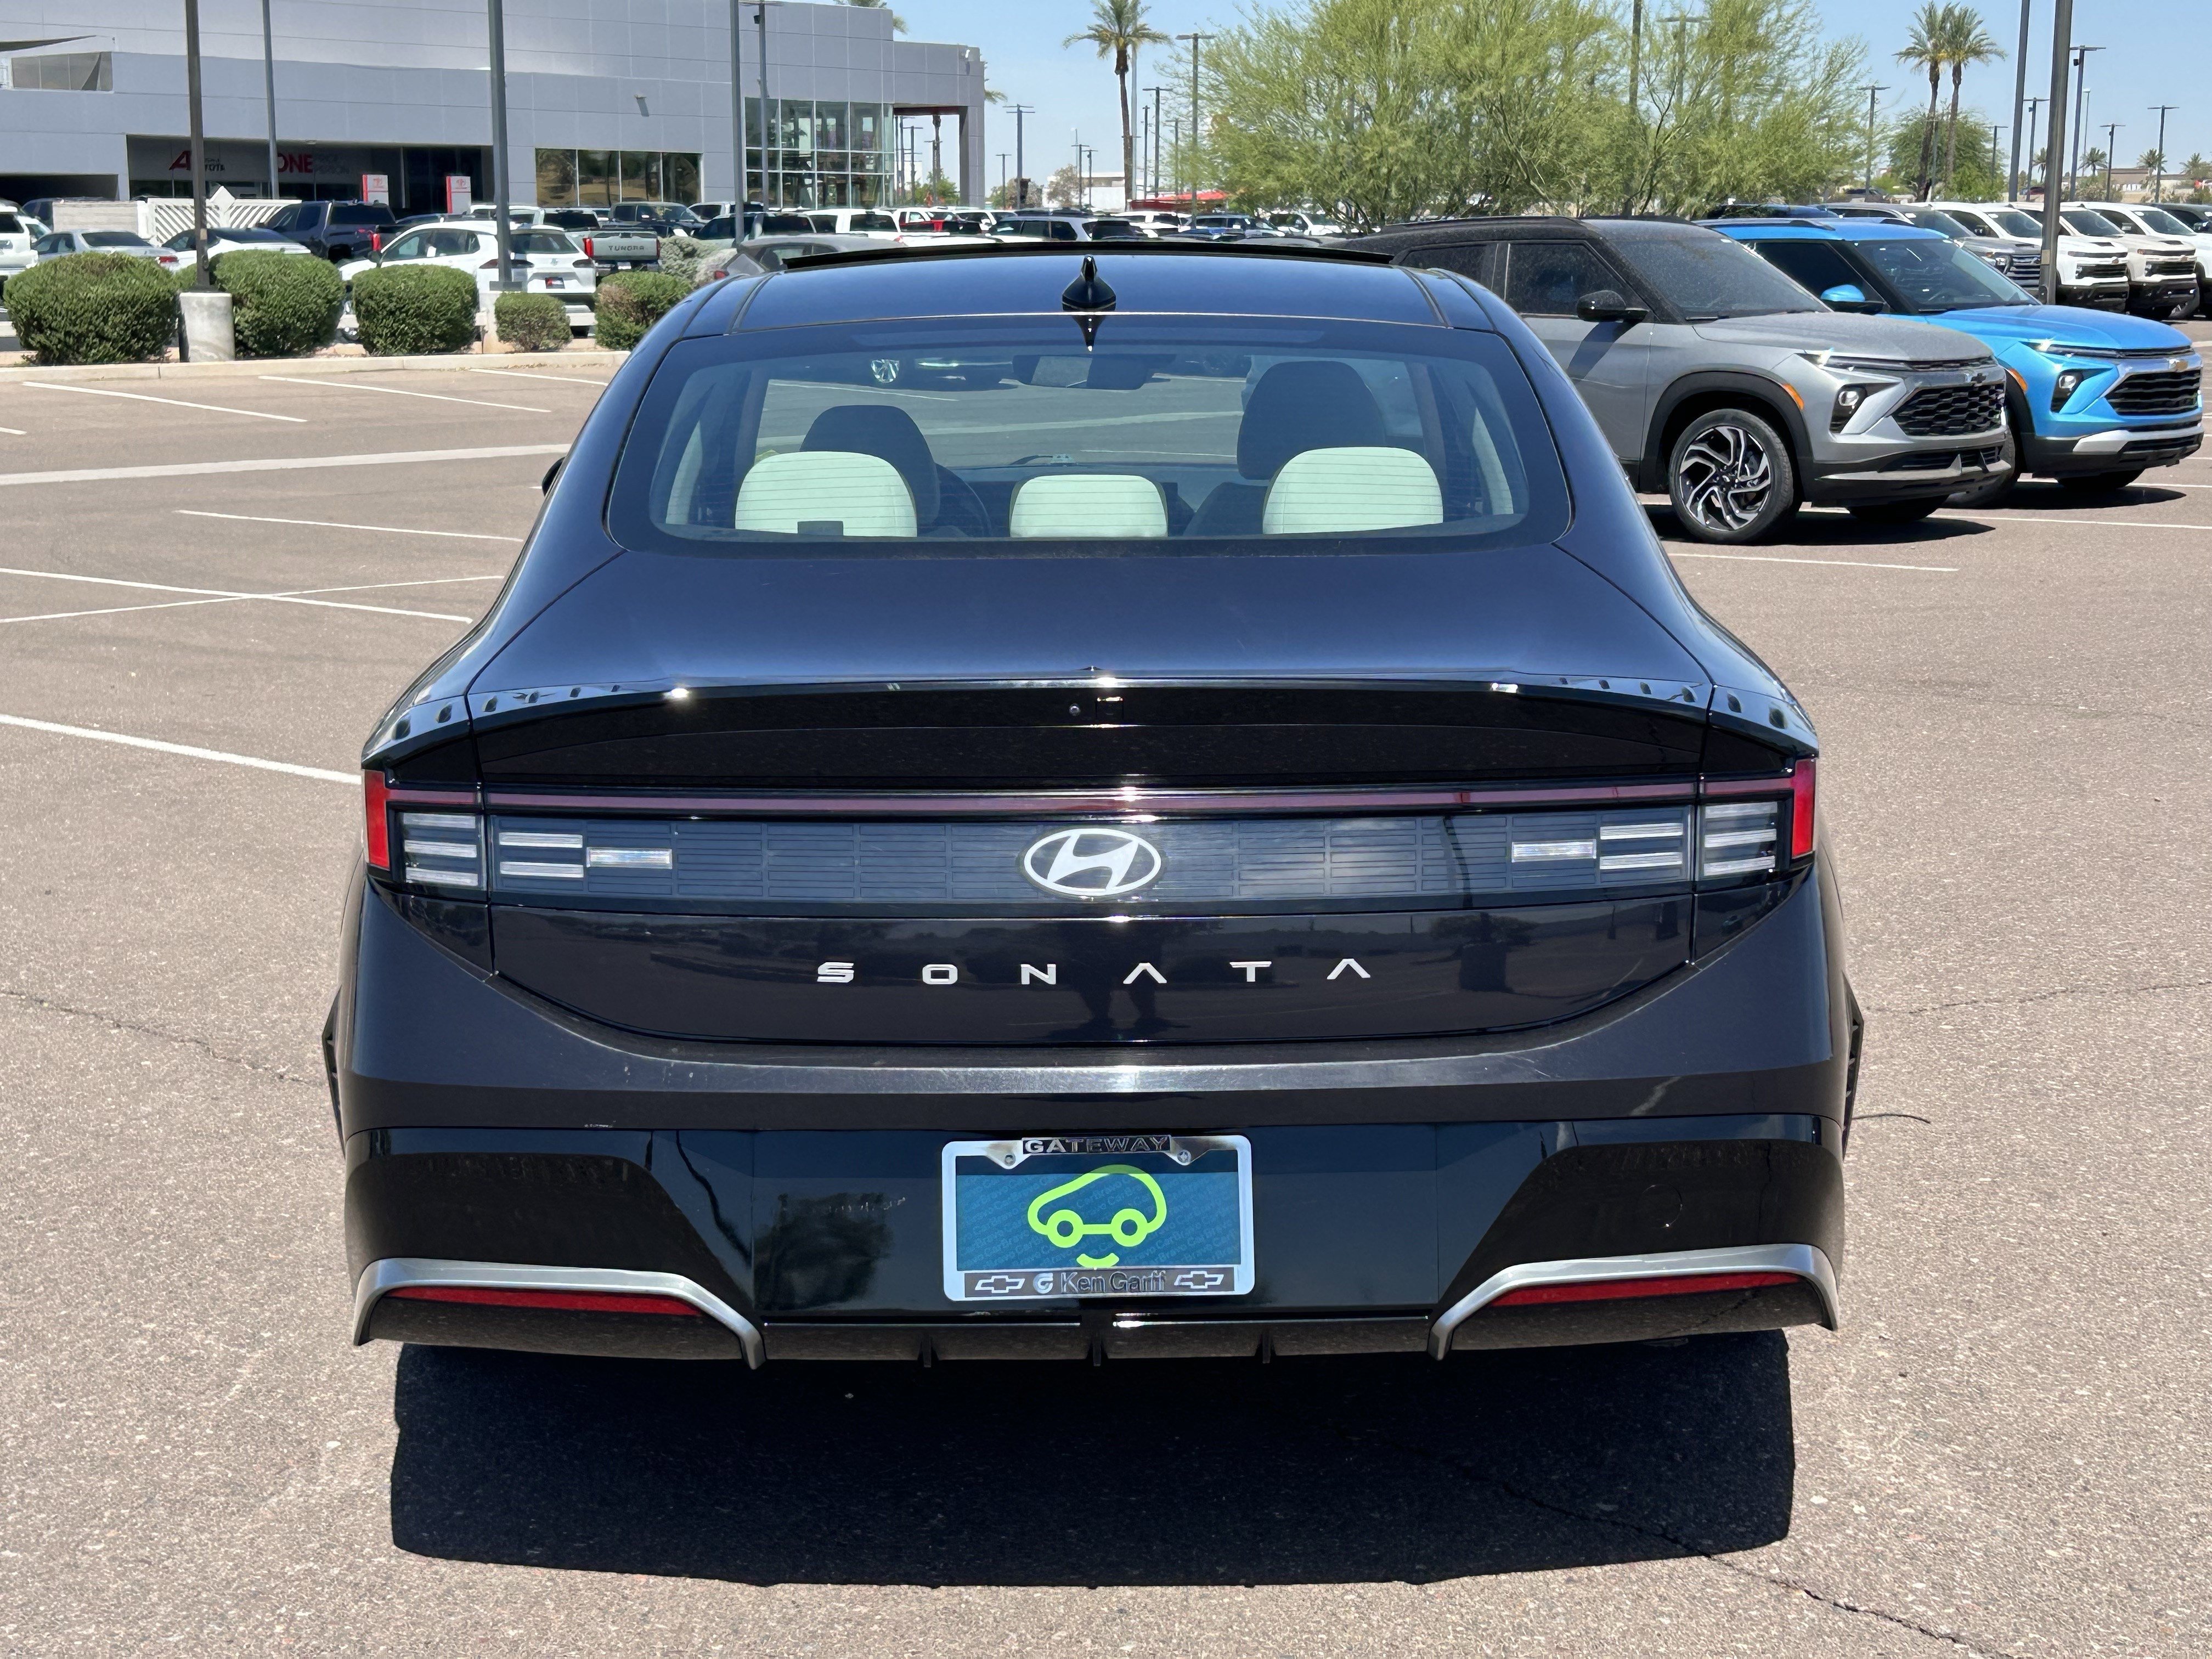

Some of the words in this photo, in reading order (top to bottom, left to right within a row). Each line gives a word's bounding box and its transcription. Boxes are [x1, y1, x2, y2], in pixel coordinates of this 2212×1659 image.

[816, 958, 1371, 985] SONATA
[1024, 1136, 1168, 1153] GATEWAY
[1060, 1272, 1105, 1294] Ken
[1109, 1269, 1166, 1293] Garff
